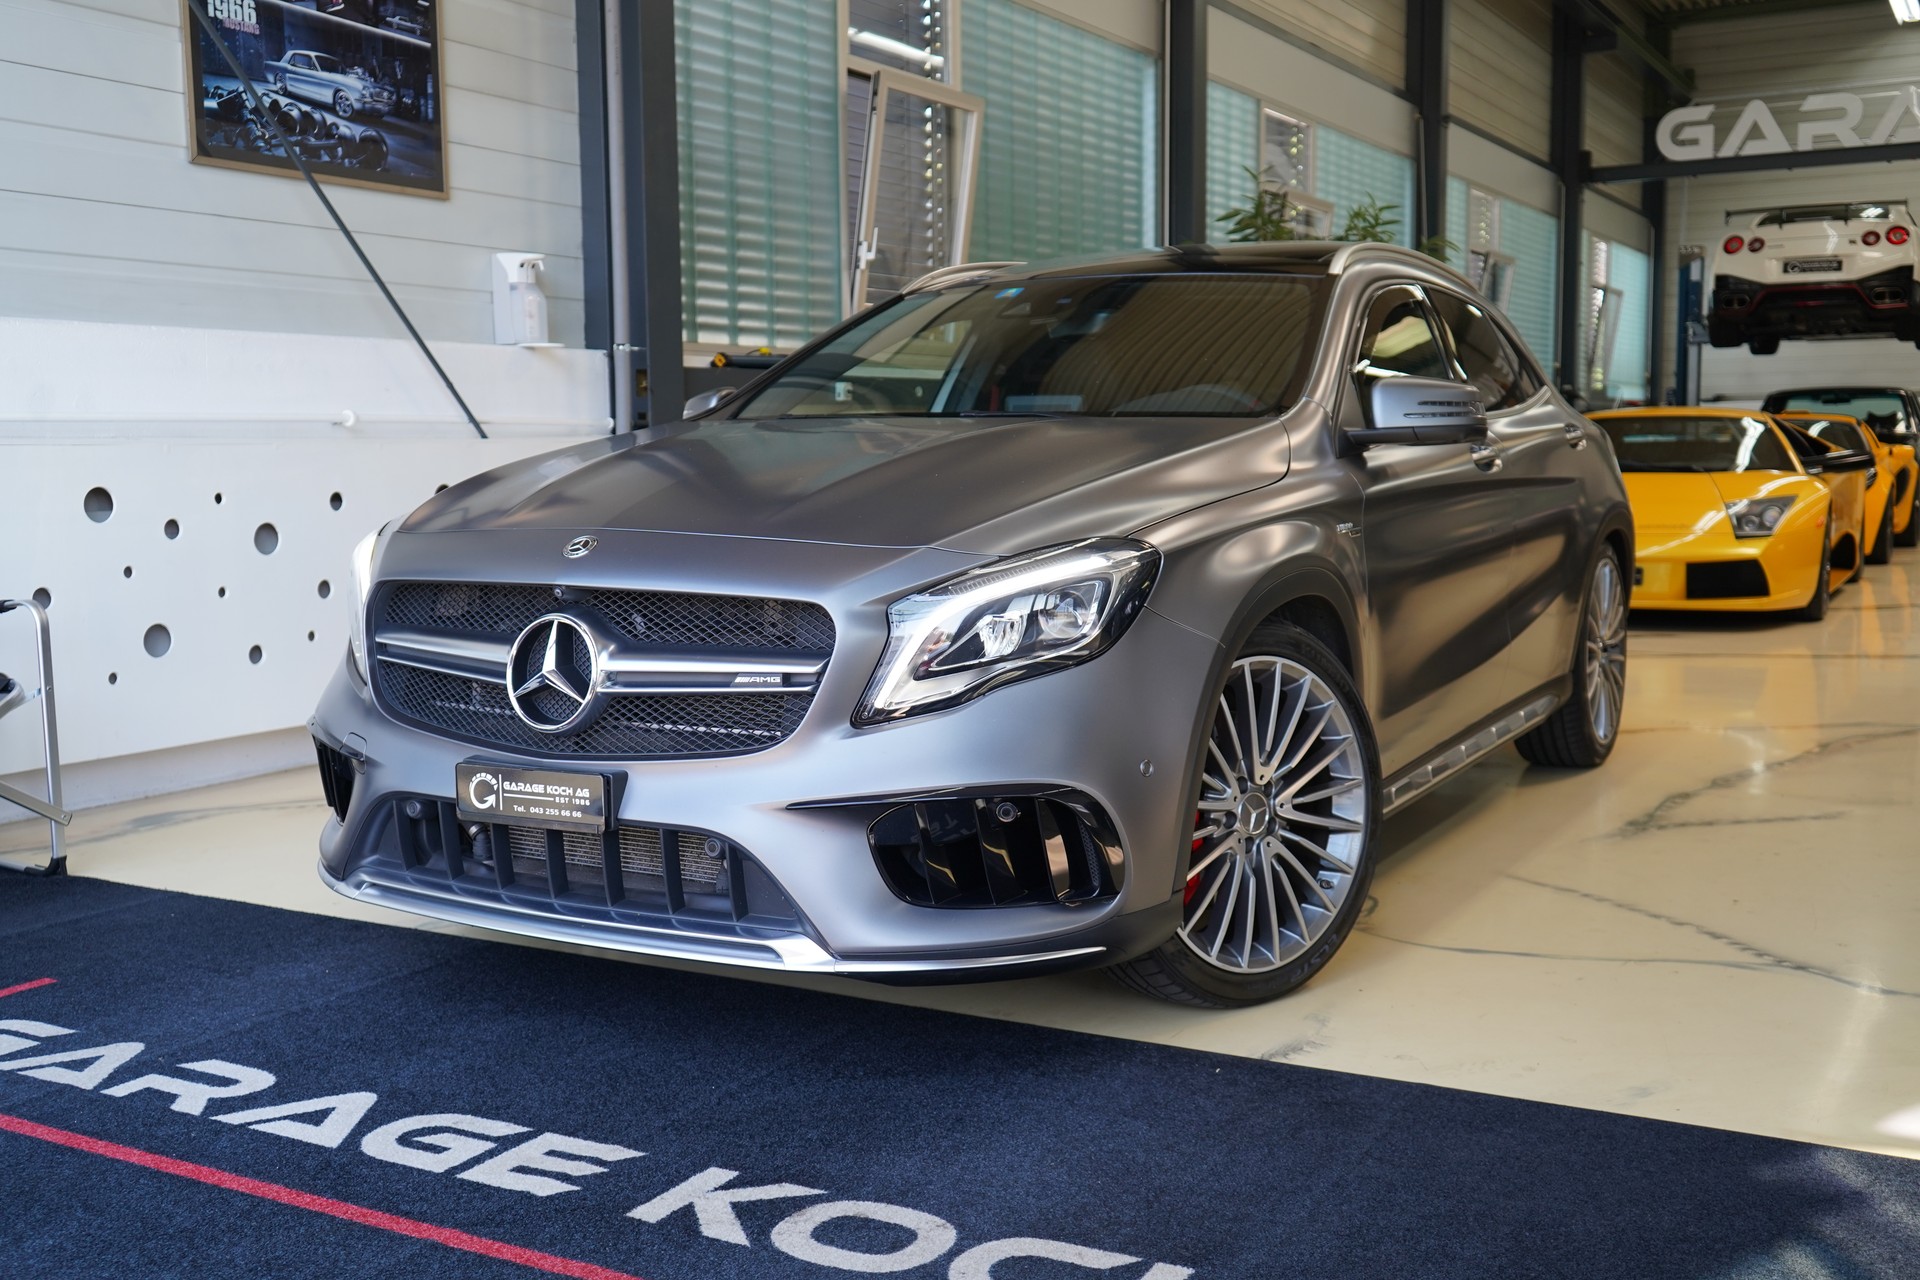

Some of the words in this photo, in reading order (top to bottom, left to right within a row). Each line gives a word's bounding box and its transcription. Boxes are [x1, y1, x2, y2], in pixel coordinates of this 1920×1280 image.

[207, 0, 257, 25] 1966
[222, 16, 260, 35] MUSTANG
[503, 781, 545, 794] GARAGE
[546, 785, 573, 797] KOCH
[575, 788, 590, 798] AG
[555, 796, 569, 804] EST
[571, 797, 590, 806] 1986
[513, 804, 526, 813] Tel.
[529, 806, 544, 815] 043
[545, 808, 559, 816] 255
[561, 809, 571, 817] 66
[572, 810, 582, 818] 66
[625, 1166, 1195, 1280] KOC
